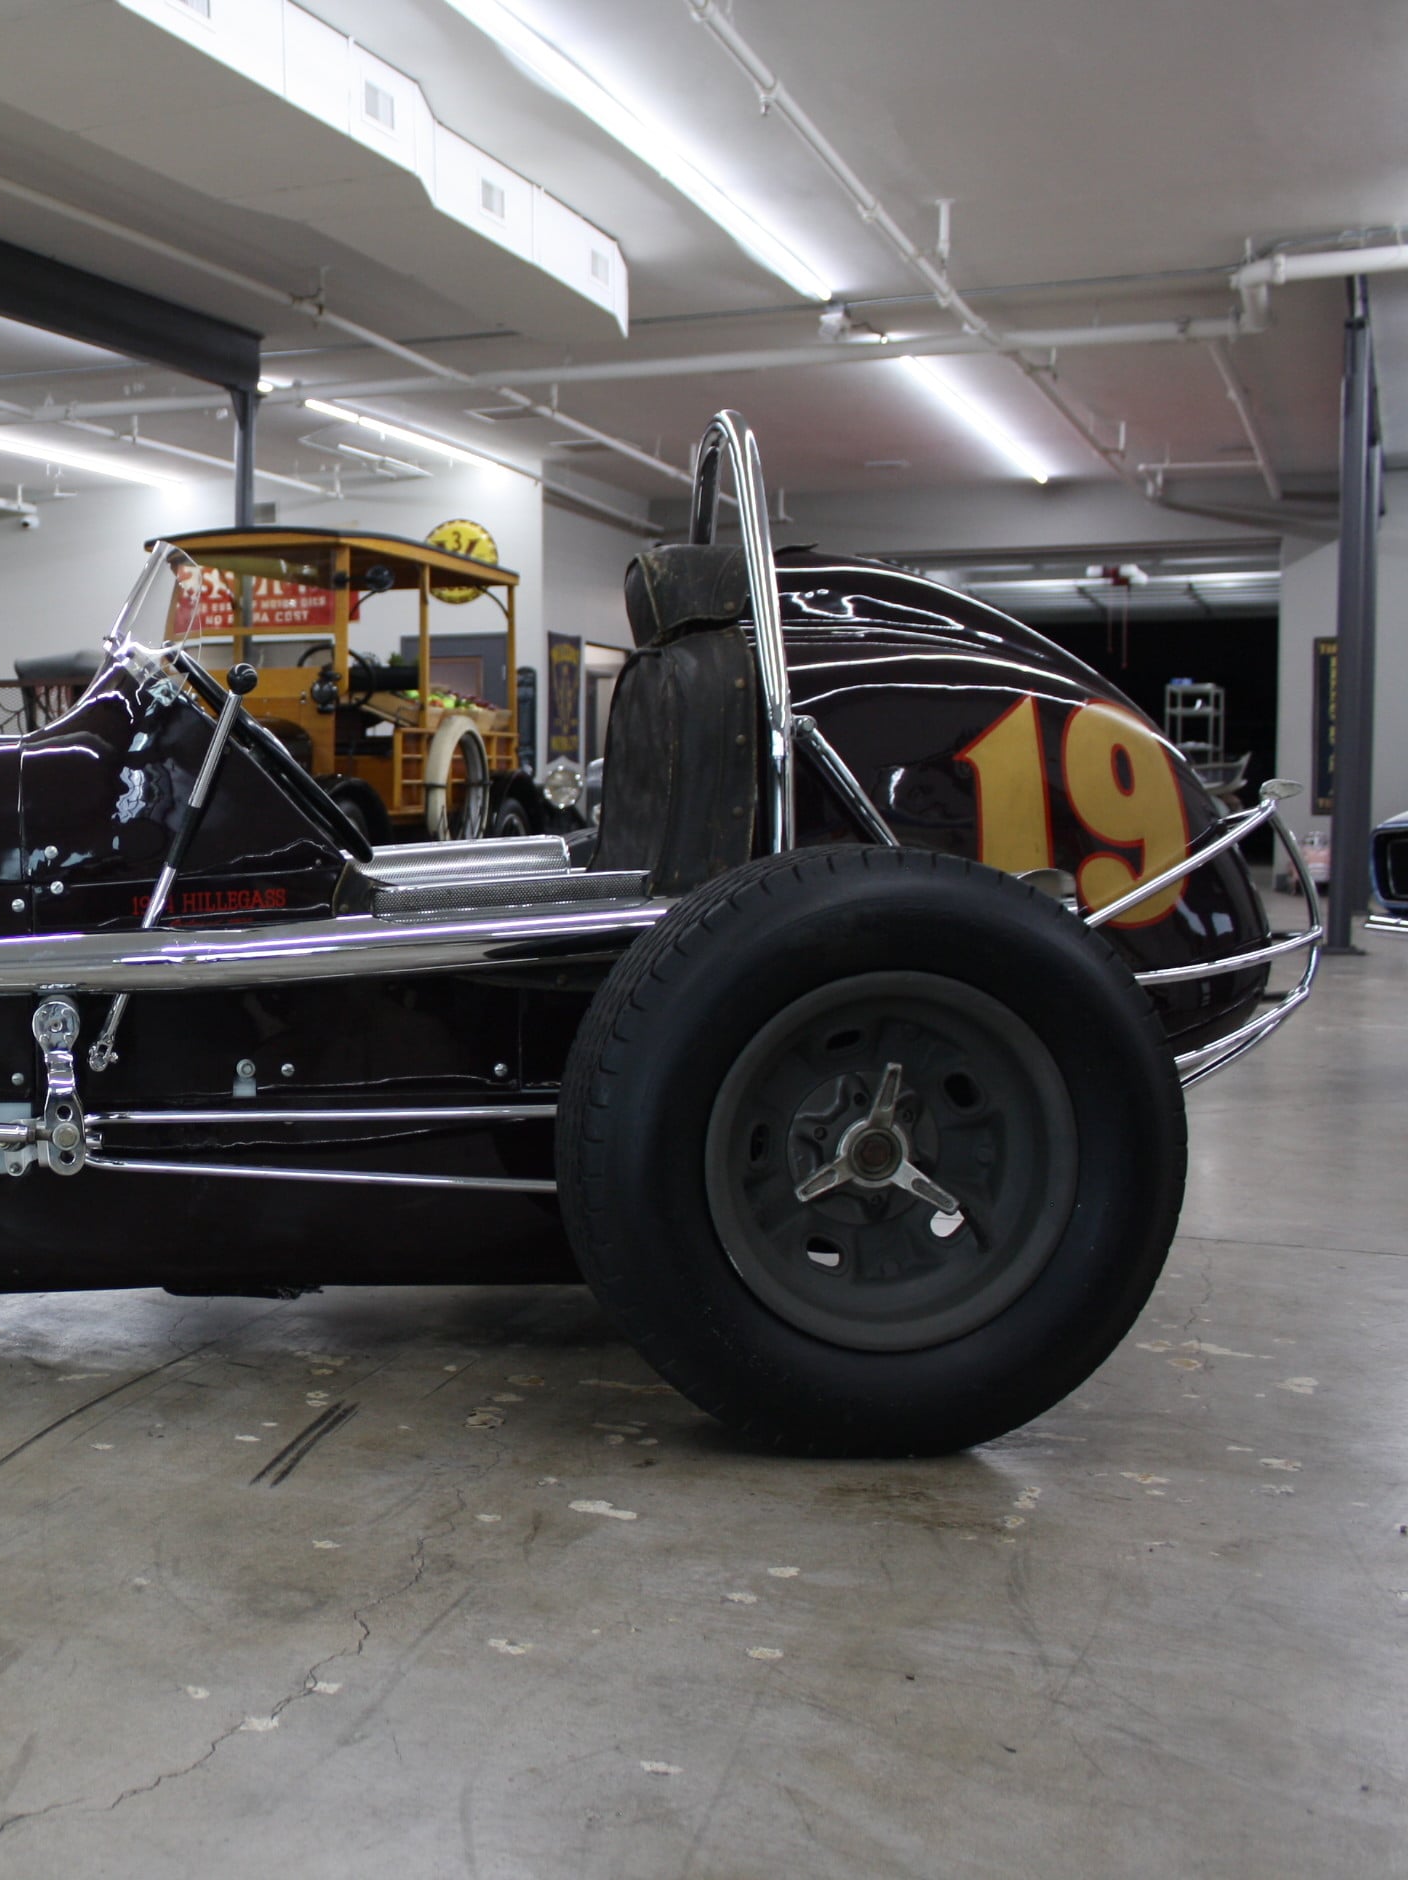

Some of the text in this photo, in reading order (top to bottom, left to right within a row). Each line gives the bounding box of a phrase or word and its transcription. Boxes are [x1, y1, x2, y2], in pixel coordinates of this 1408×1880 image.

[275, 610, 310, 623] COST
[952, 688, 1192, 930] 19
[182, 888, 287, 913] HILLEGASS
